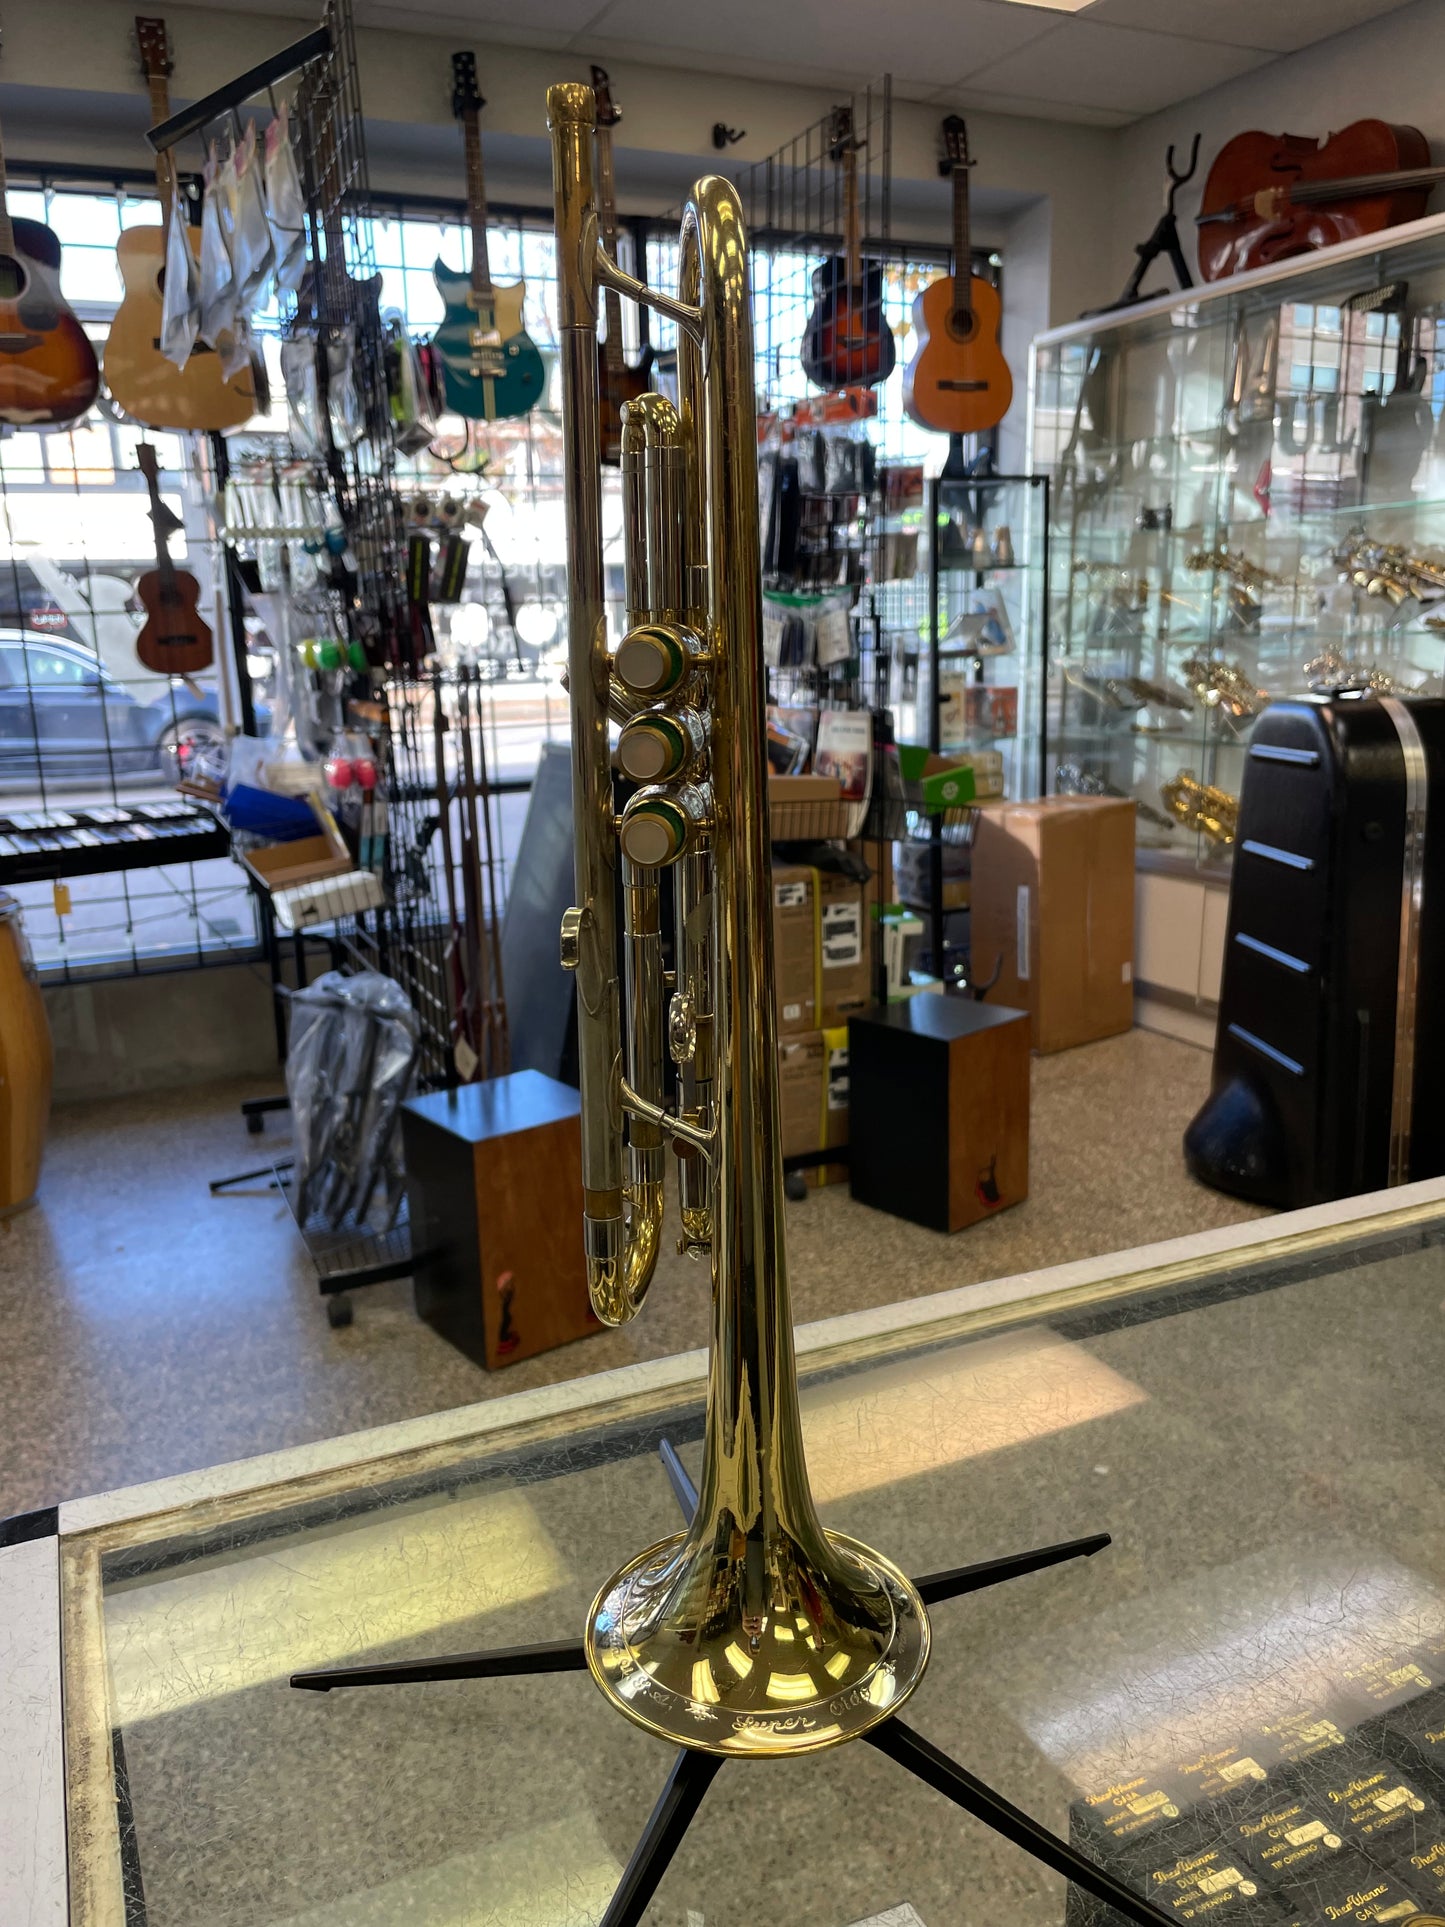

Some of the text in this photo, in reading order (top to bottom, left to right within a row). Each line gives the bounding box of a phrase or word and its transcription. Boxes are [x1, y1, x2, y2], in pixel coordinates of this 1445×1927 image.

[731, 1714, 817, 1732] Super
[1268, 1822, 1295, 1838] GAIA
[1261, 1842, 1288, 1859] MODEL
[1283, 1844, 1318, 1864] OPENING
[1176, 1866, 1217, 1889] DURGA
[1172, 1889, 1202, 1908] MODEL
[1182, 1892, 1233, 1919] TIP OPENING
[1355, 1903, 1383, 1921] GAIA
